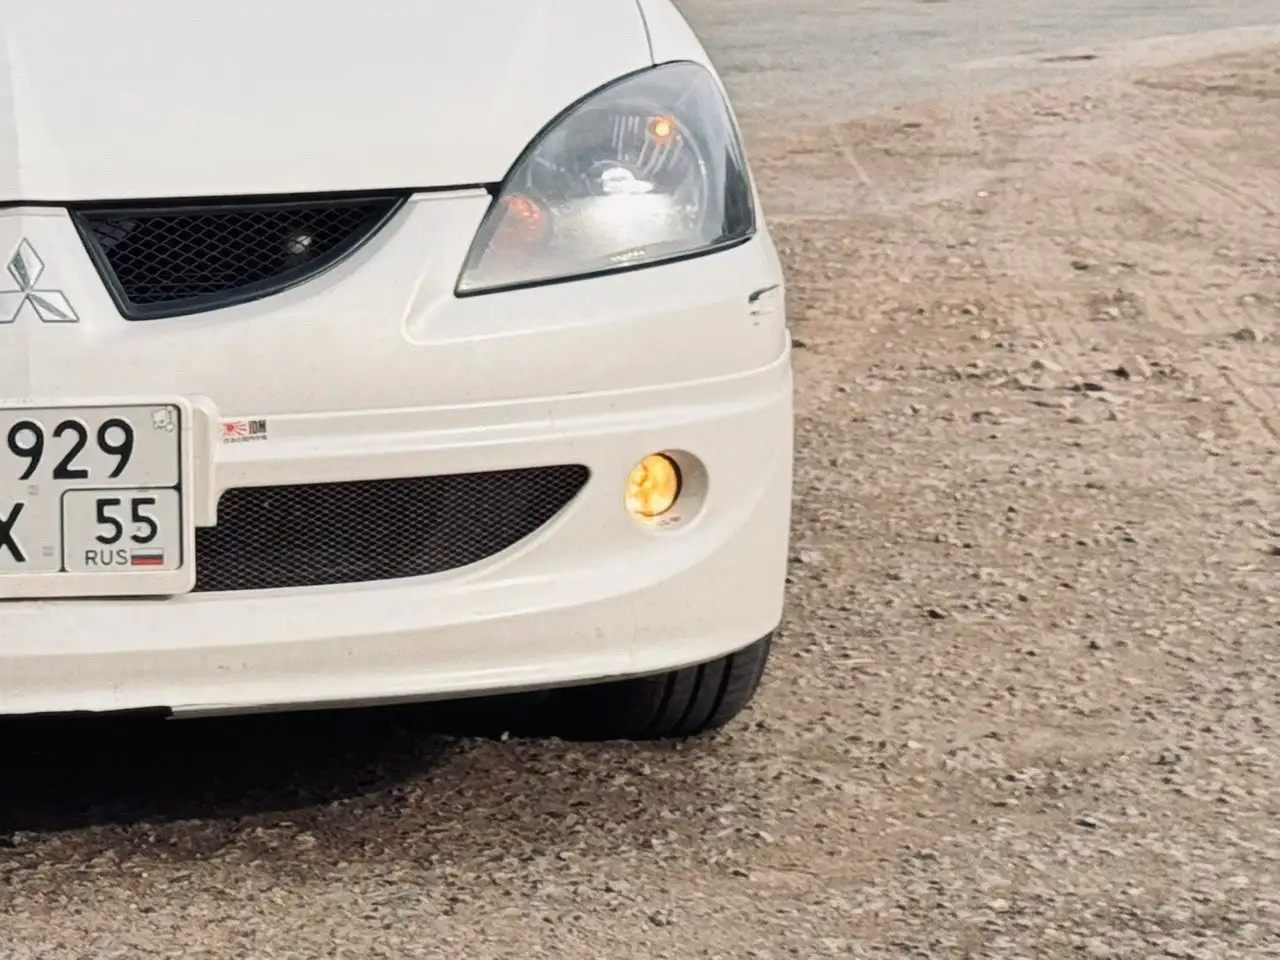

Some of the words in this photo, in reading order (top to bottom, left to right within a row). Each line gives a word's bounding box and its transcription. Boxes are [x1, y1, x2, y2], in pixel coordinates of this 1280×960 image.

[6, 417, 135, 480] 929
[95, 497, 158, 544] 55
[84, 548, 128, 566] RUS
